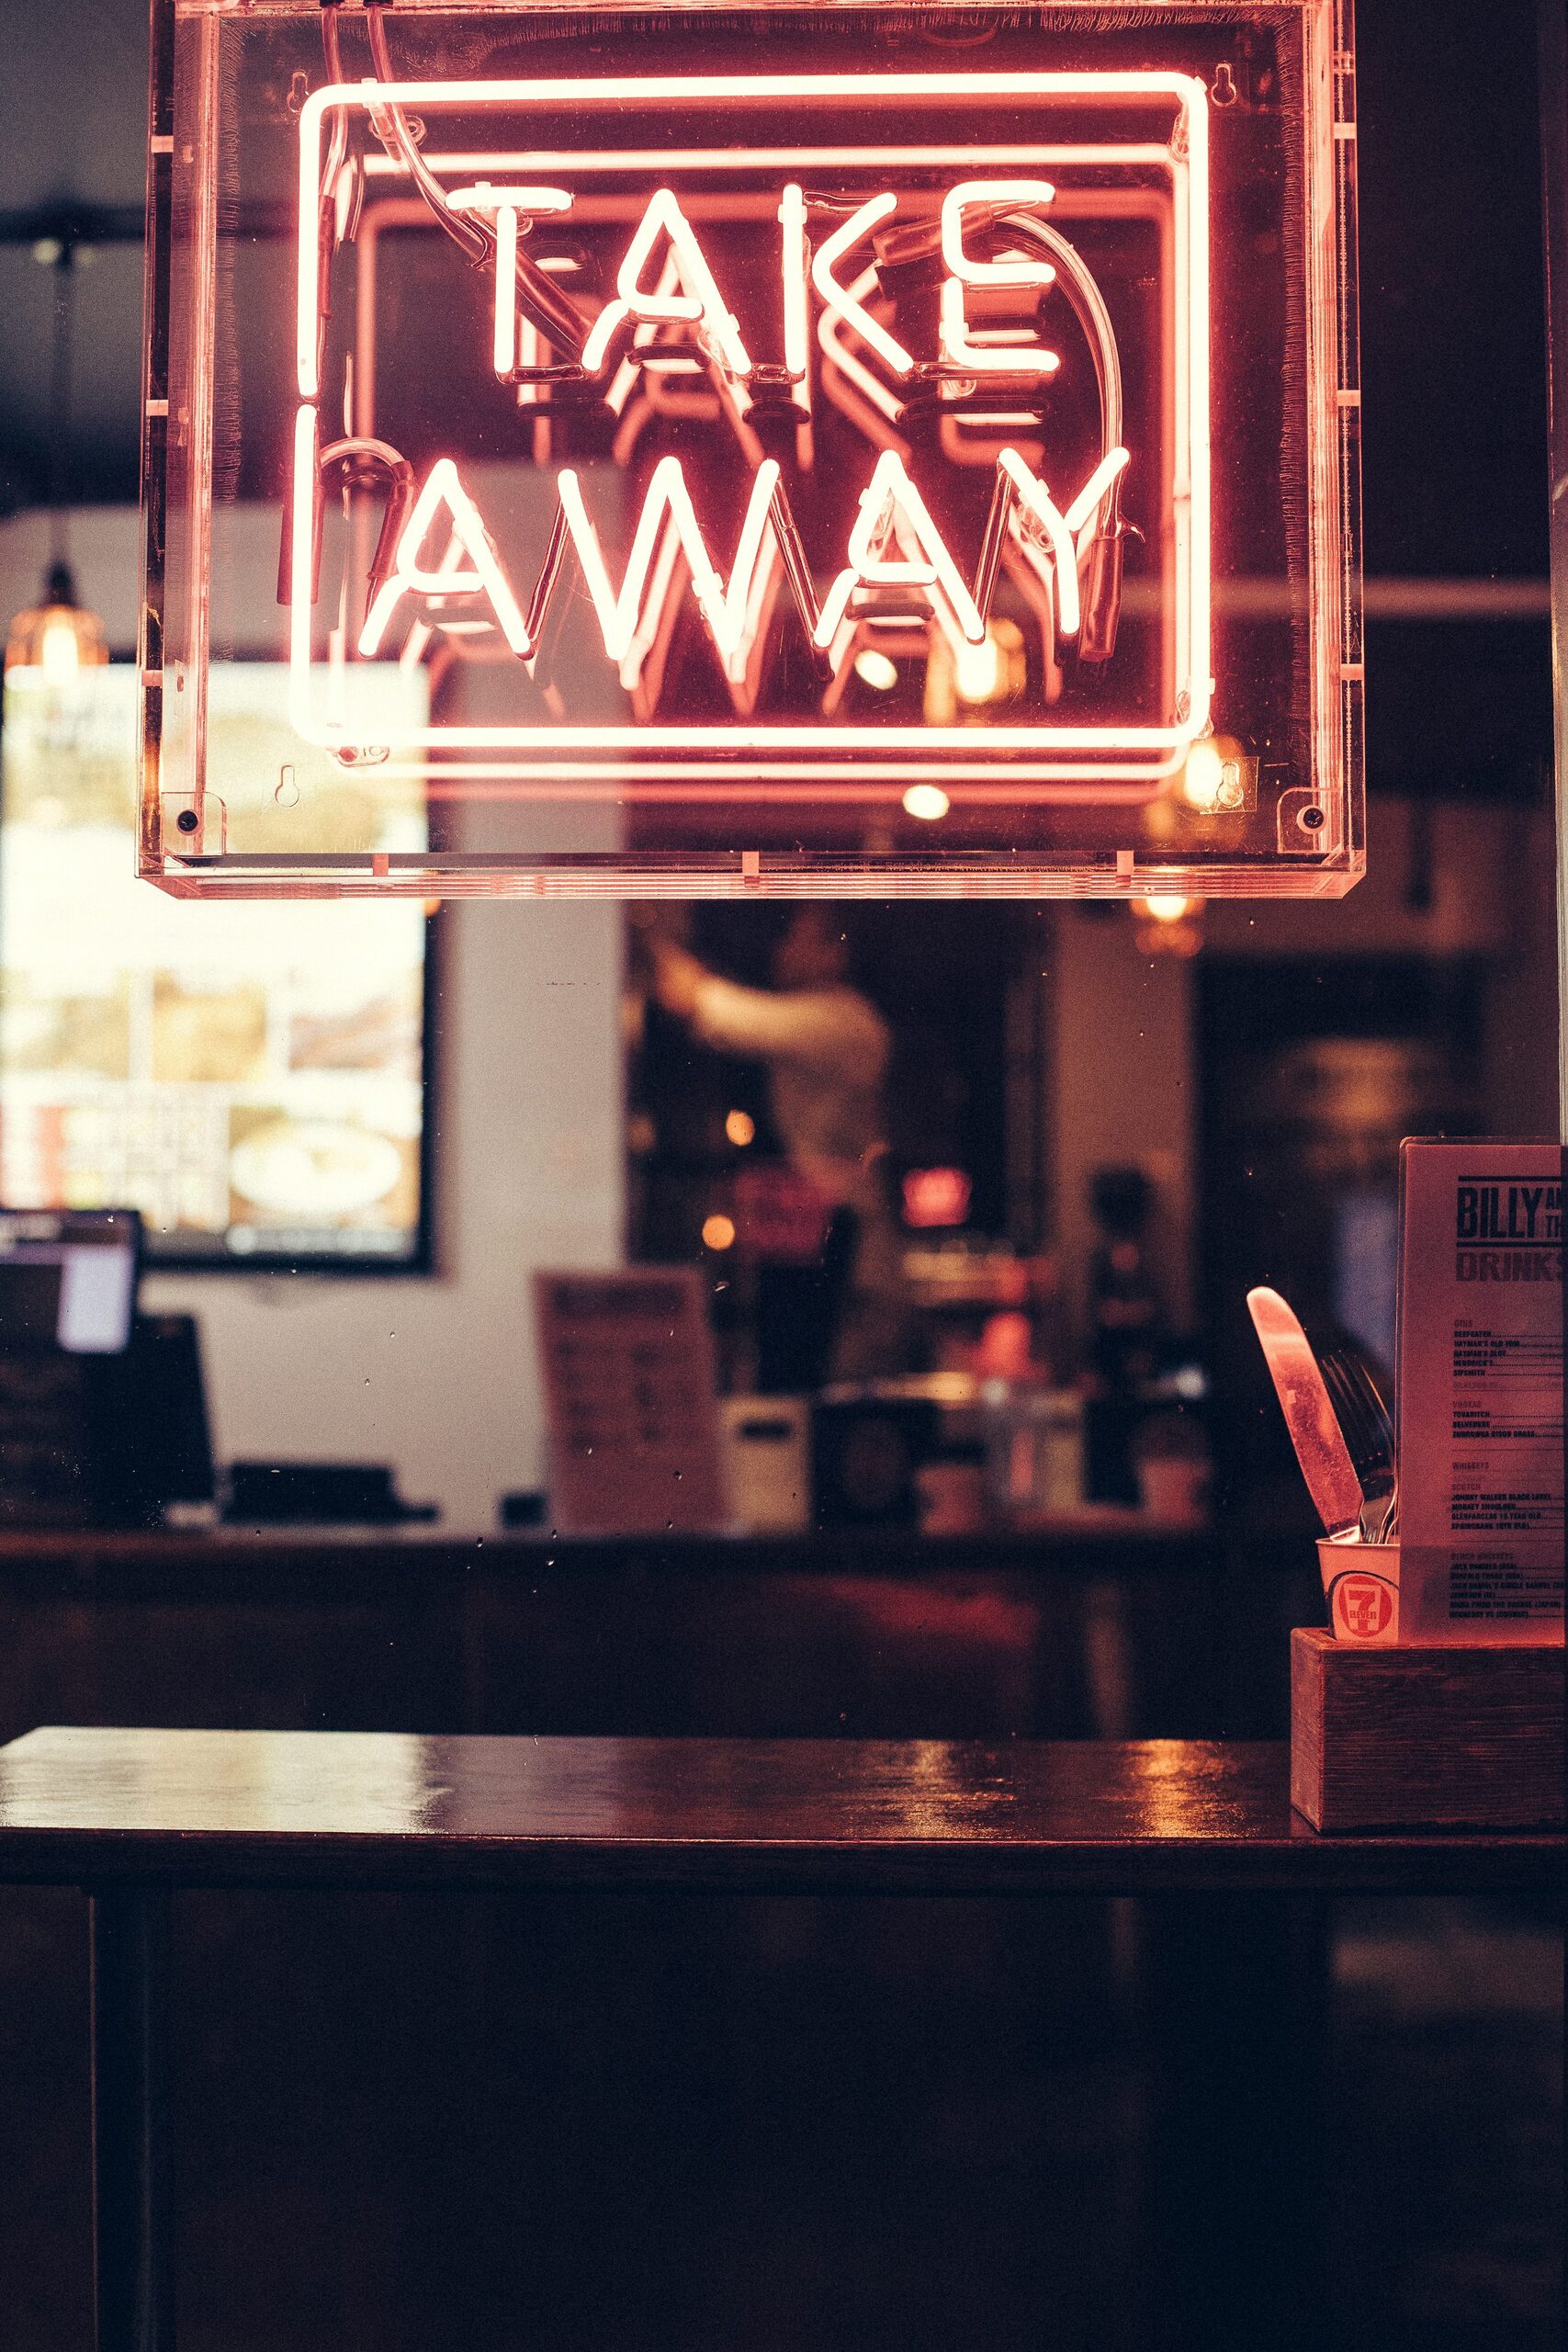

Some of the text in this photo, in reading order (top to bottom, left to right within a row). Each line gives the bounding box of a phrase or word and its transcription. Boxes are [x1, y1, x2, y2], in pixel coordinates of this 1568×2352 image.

[445, 180, 1063, 379] TAKE
[357, 447, 1132, 660] AWAY
[1457, 1187, 1543, 1238] BILLY
[1452, 1420, 1491, 1429] BELVEDERE
[1348, 1589, 1376, 1632] 7
